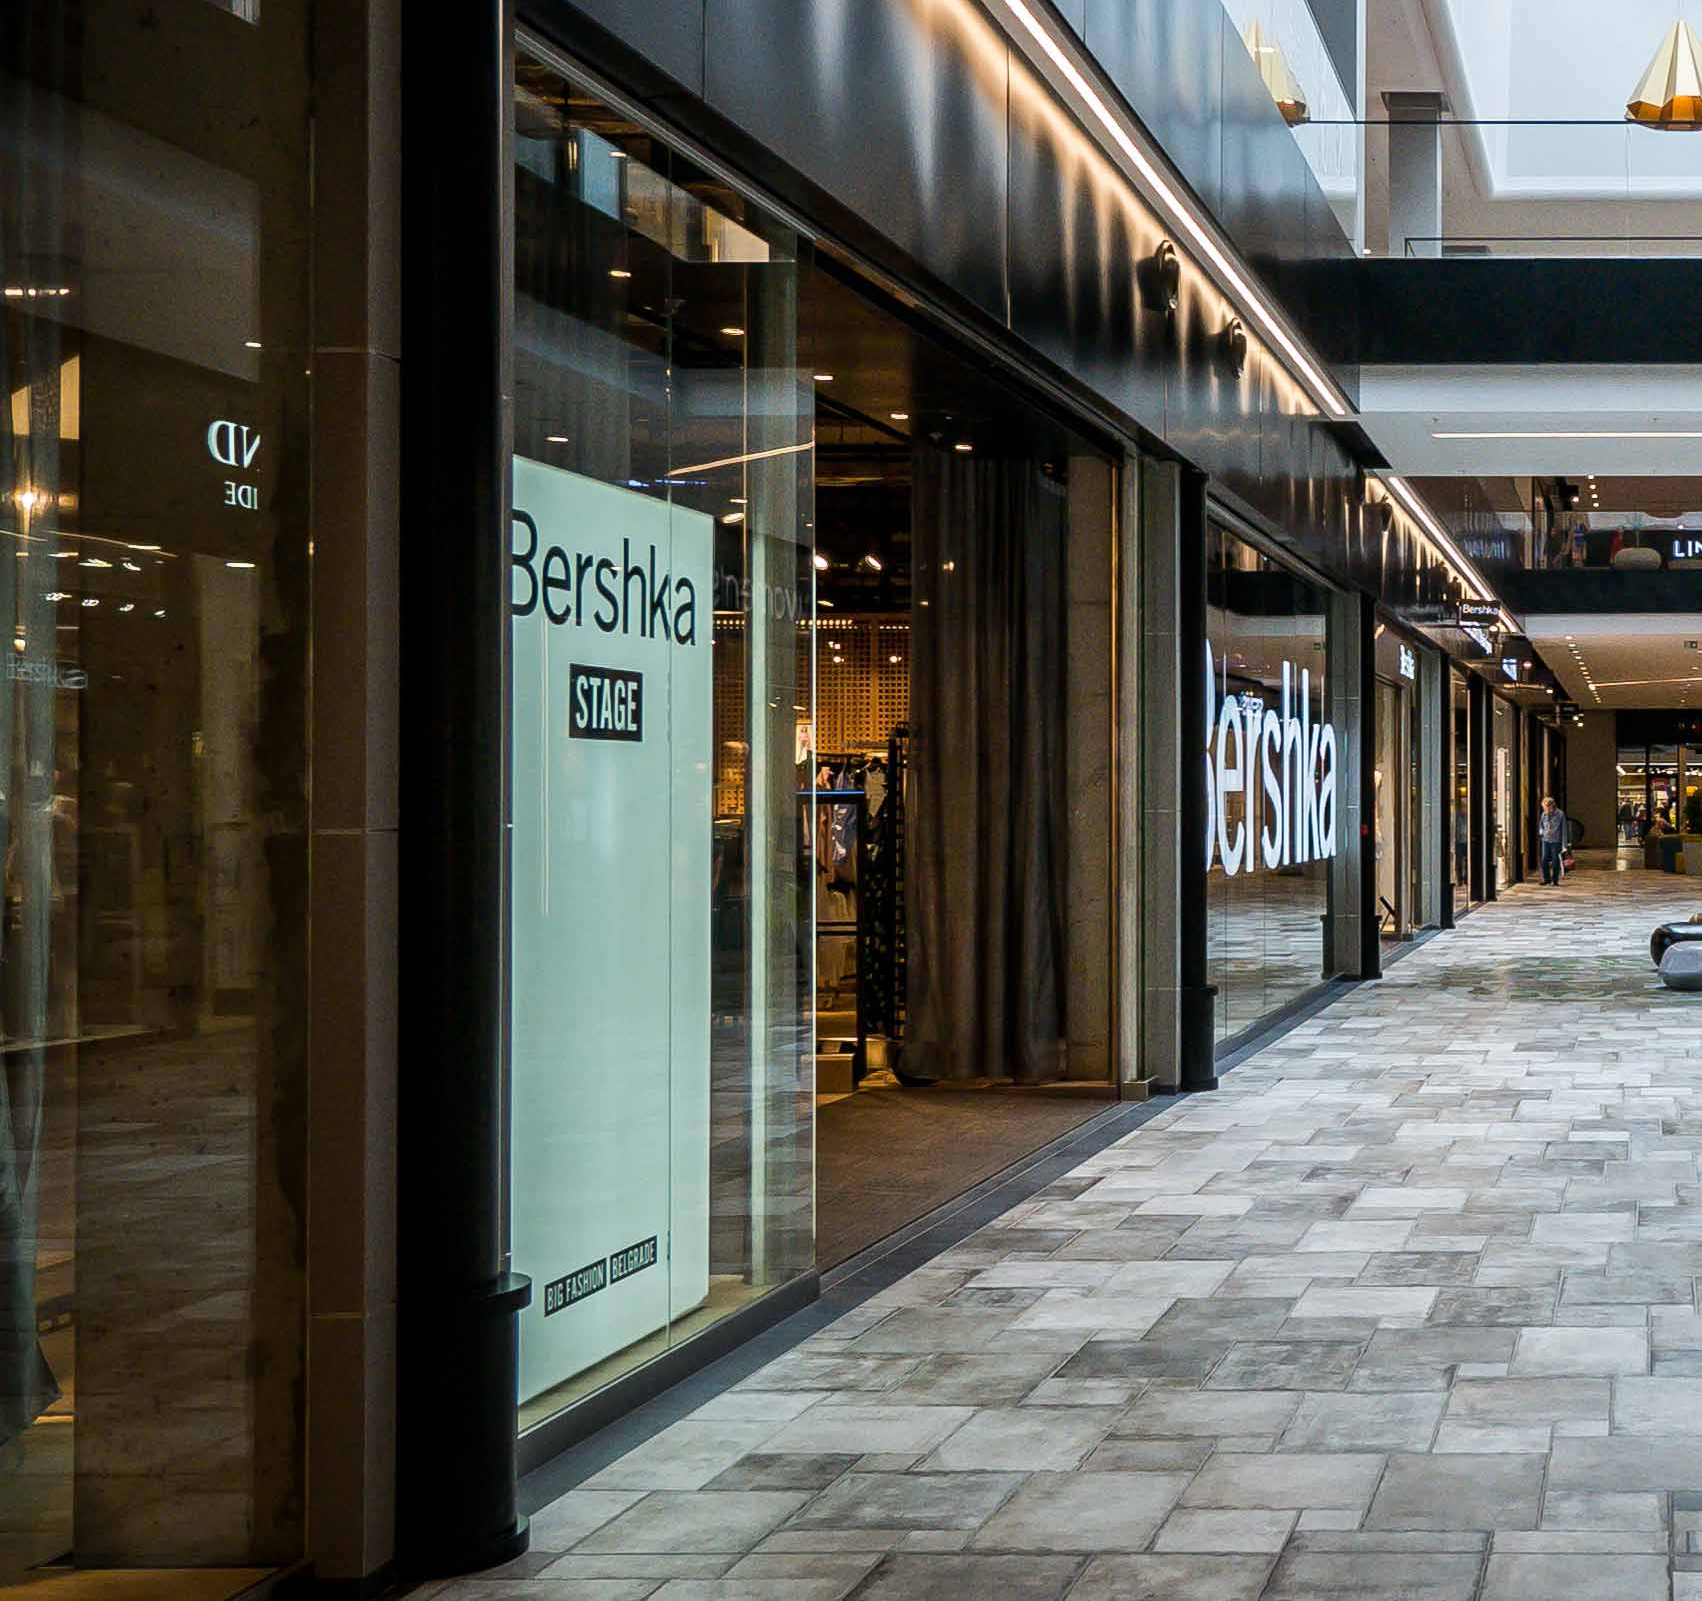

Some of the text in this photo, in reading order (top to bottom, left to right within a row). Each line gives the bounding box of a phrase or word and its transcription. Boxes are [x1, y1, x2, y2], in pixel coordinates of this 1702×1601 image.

[511, 508, 696, 647] Bershka
[1462, 603, 1500, 616] Bershka
[575, 675, 638, 732] STAGE
[1206, 638, 1336, 877] ershka
[547, 1240, 656, 1311] BIG FASHION BELGRADE
